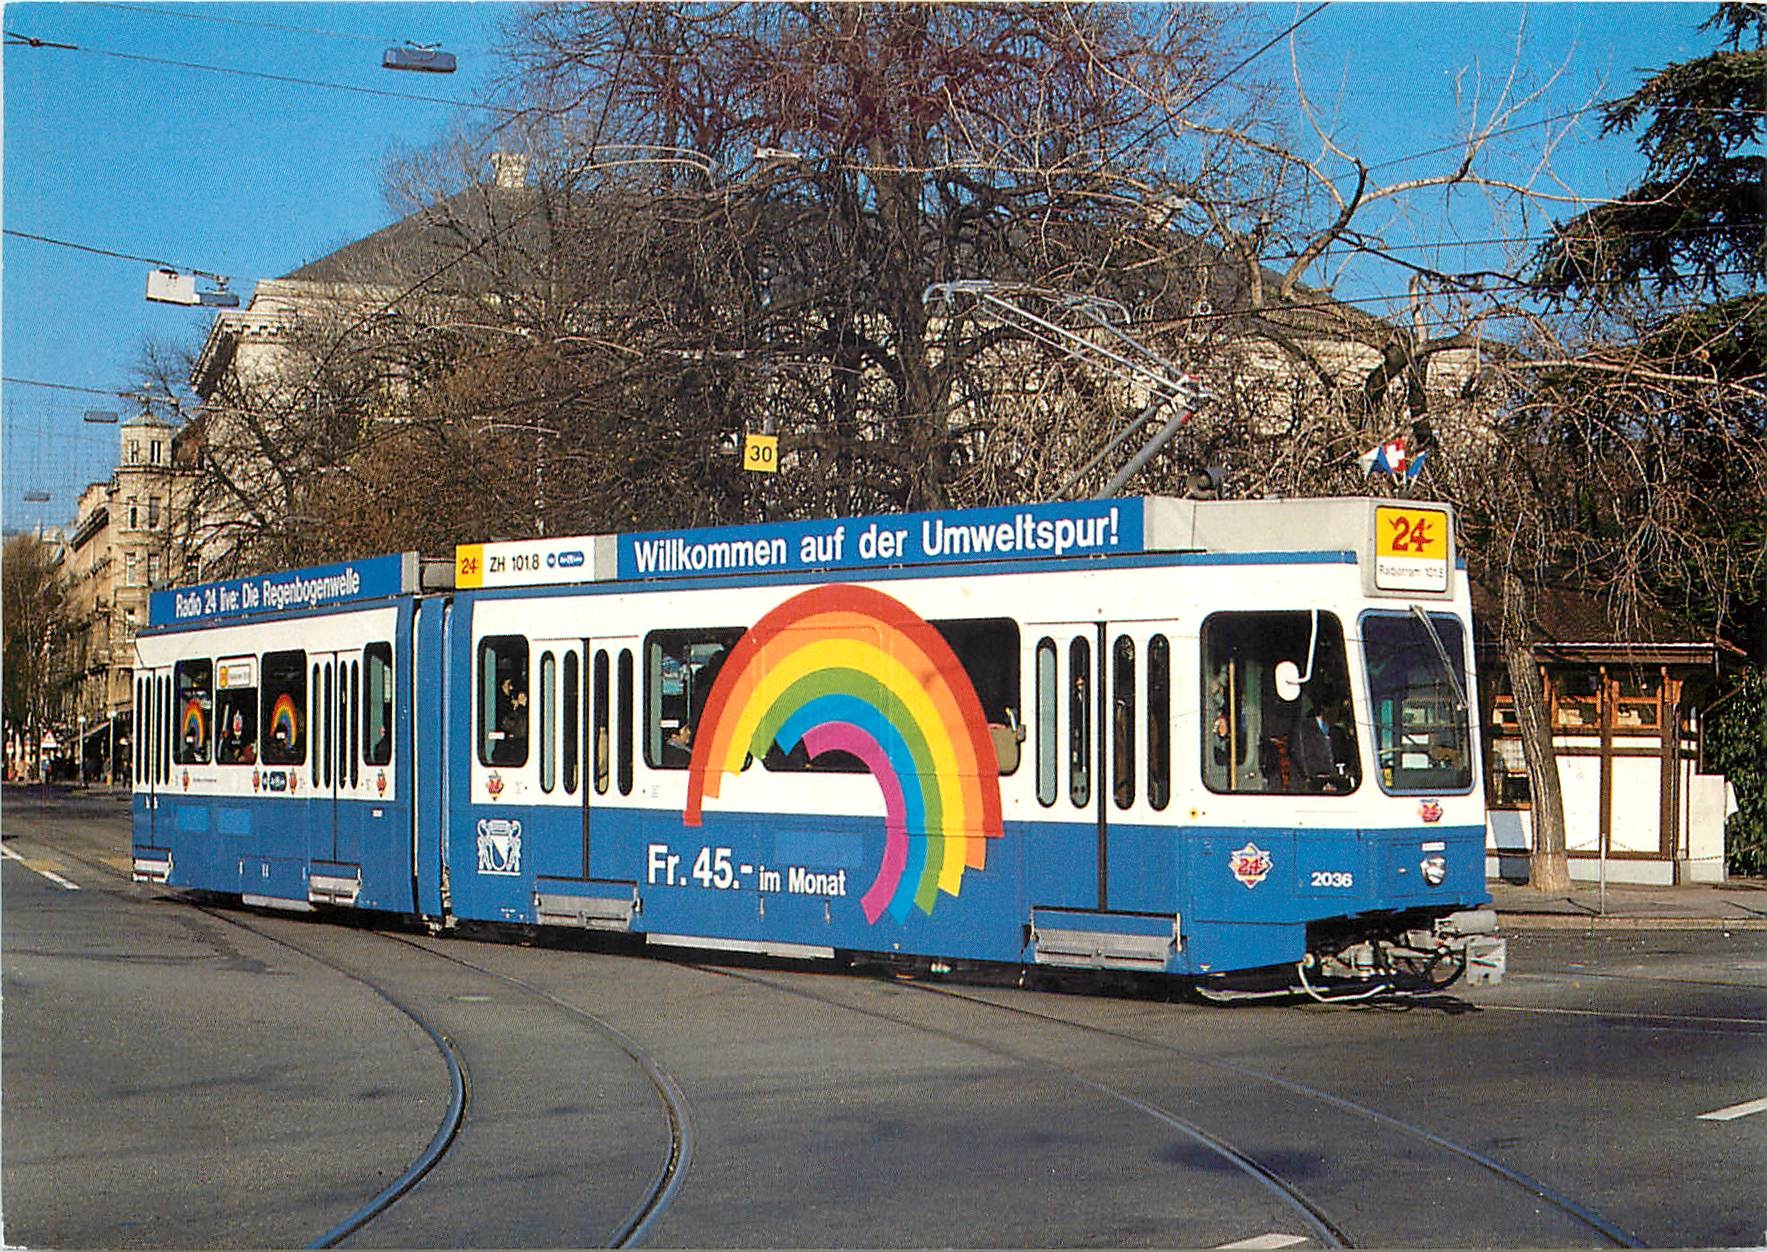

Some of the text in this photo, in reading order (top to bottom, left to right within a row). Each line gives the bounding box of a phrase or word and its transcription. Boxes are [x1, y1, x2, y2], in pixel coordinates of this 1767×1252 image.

[750, 445, 772, 462] 30
[633, 507, 1119, 573] Willkommen auf der Umweltspur!
[1387, 515, 1435, 552] 24
[461, 557, 479, 575] 24
[489, 556, 505, 572] ZH
[175, 567, 360, 618] Radio 24 live: Die Regenbogenwelle
[648, 844, 688, 887] Fr.
[759, 864, 781, 892] im
[788, 866, 847, 897] Monat
[1311, 872, 1353, 887] 2036
